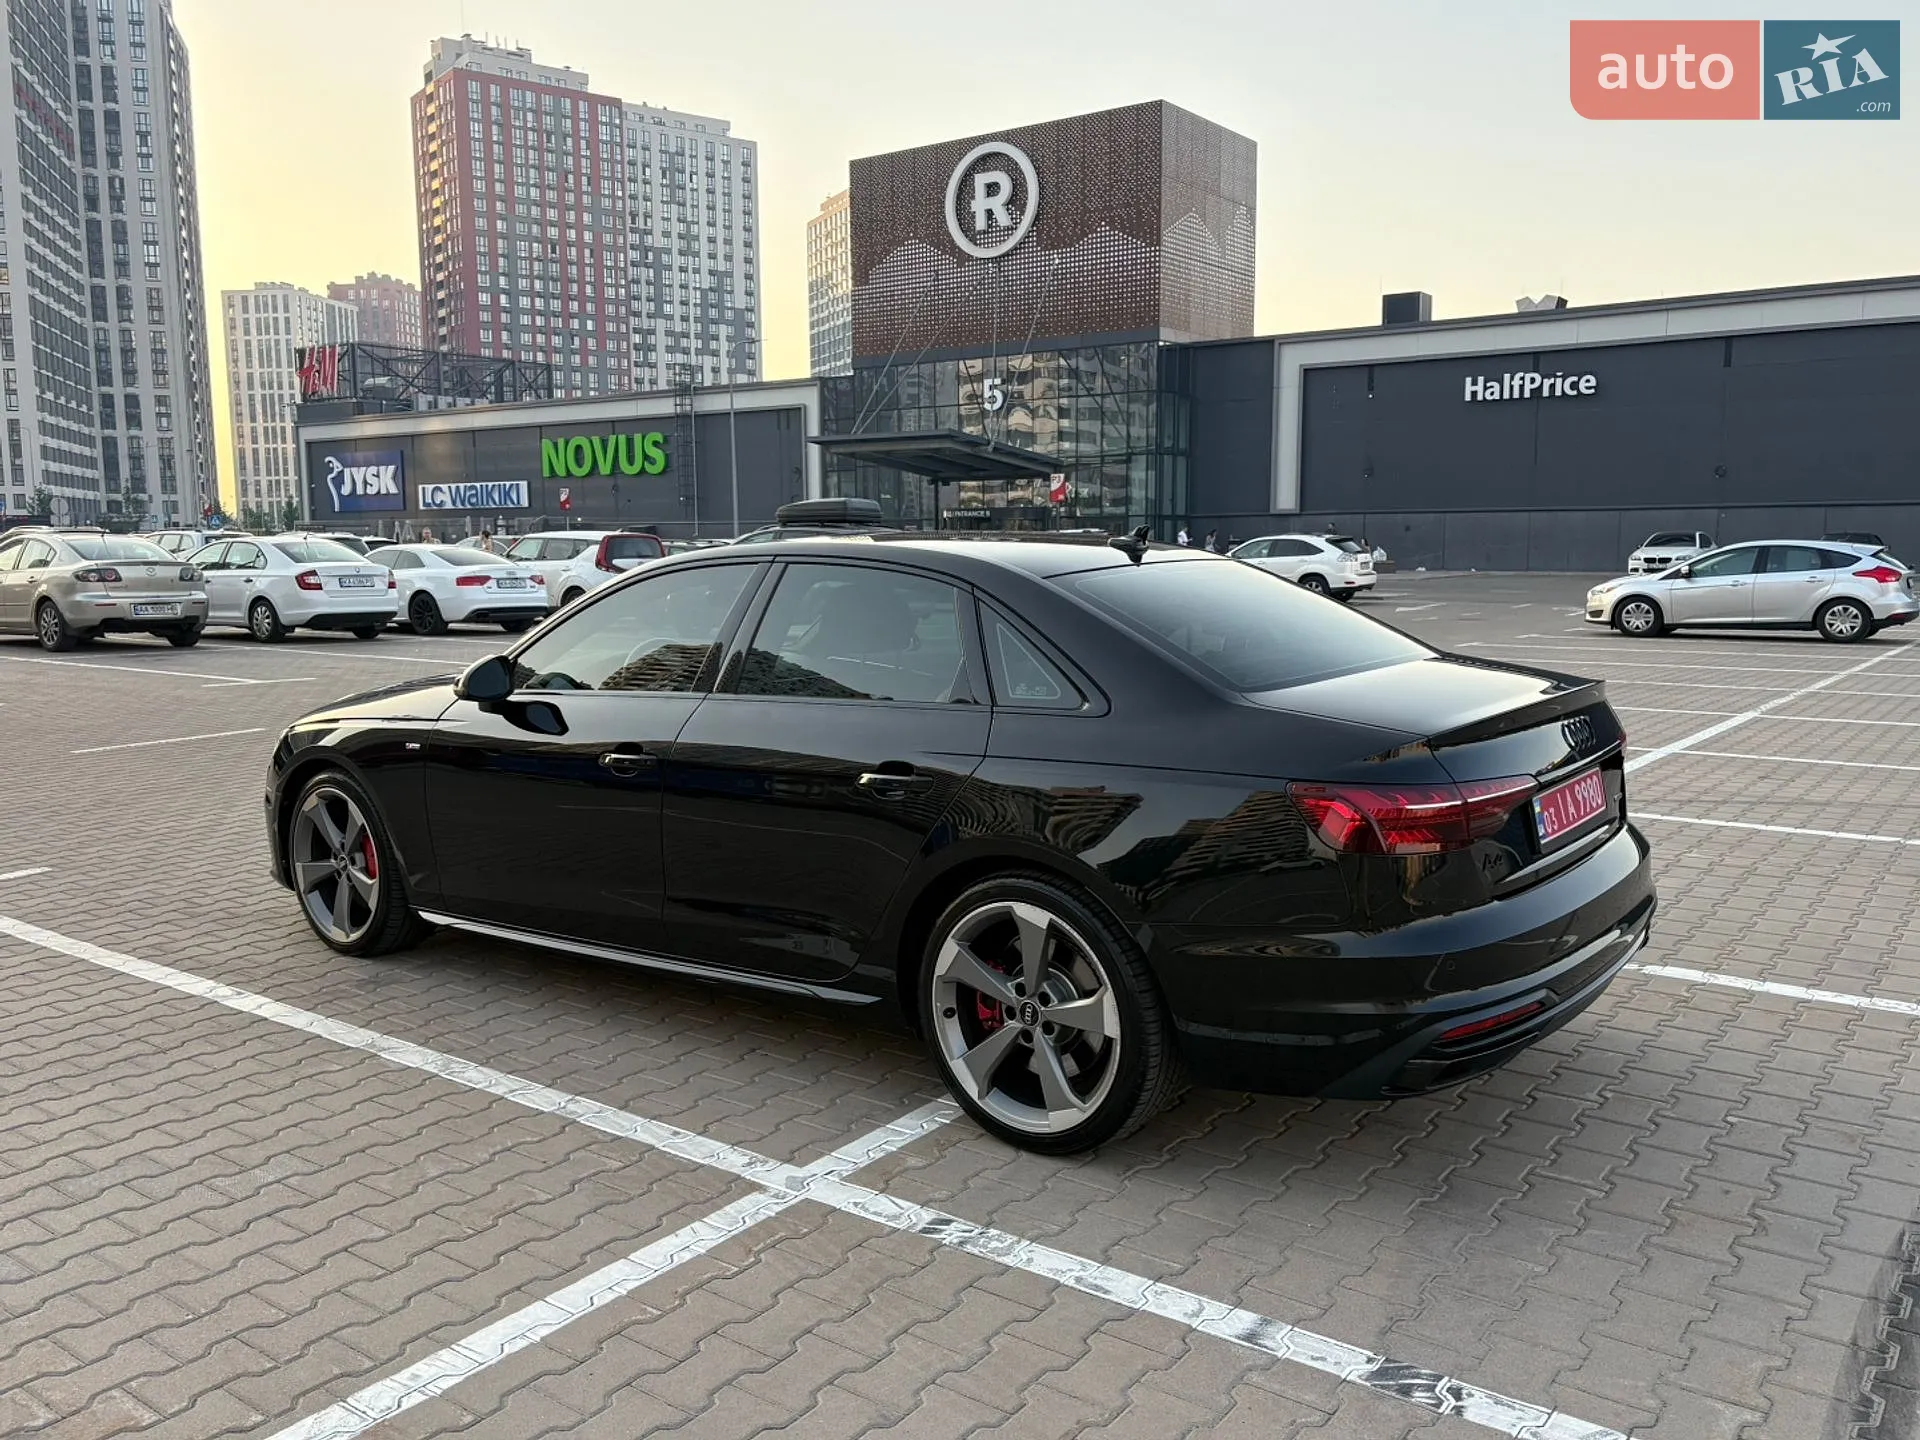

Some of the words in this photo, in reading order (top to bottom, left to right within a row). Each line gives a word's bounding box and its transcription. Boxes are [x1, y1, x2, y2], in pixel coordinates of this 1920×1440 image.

[983, 378, 1004, 411] 5
[1464, 372, 1597, 401] HalfPrice
[542, 431, 666, 478] NOVUS
[341, 465, 399, 496] JYSK
[421, 485, 445, 508] LC
[1543, 807, 1559, 835] 03
[1574, 775, 1602, 816] 9980
